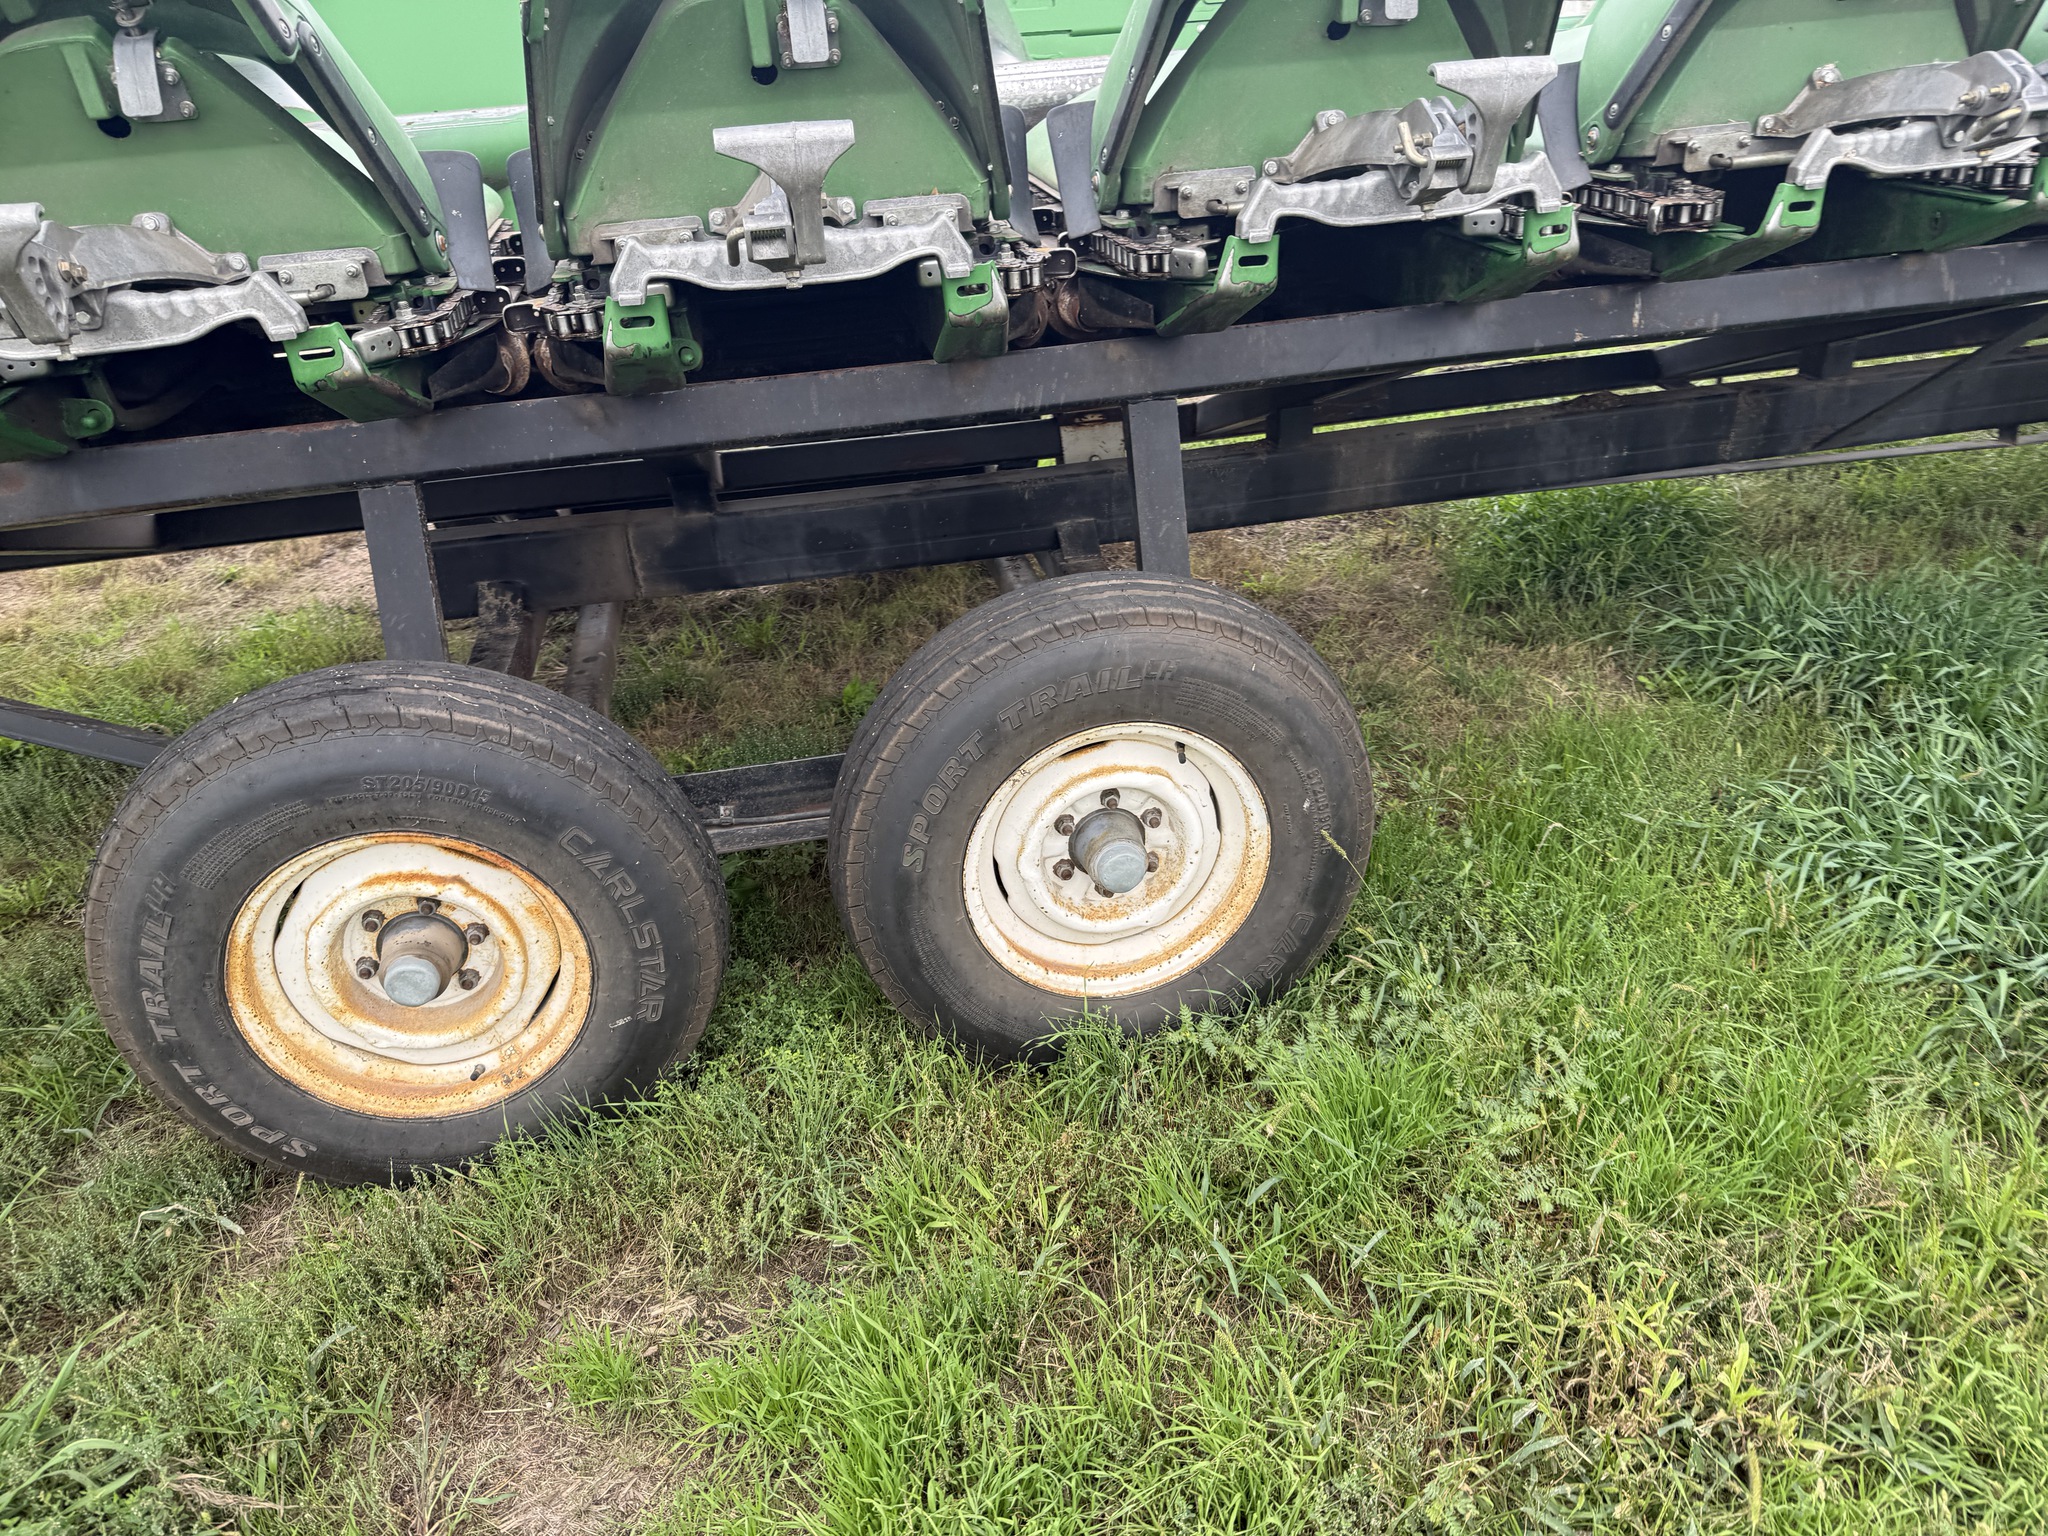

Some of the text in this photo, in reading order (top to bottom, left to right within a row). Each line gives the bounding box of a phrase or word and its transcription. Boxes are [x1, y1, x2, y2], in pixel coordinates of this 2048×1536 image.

[902, 730, 984, 873] SPORT
[998, 667, 1144, 729] TRAIL
[138, 911, 182, 1044] TRAIL
[558, 825, 666, 1023] CARLSTAR
[170, 1059, 319, 1160] SPORT
